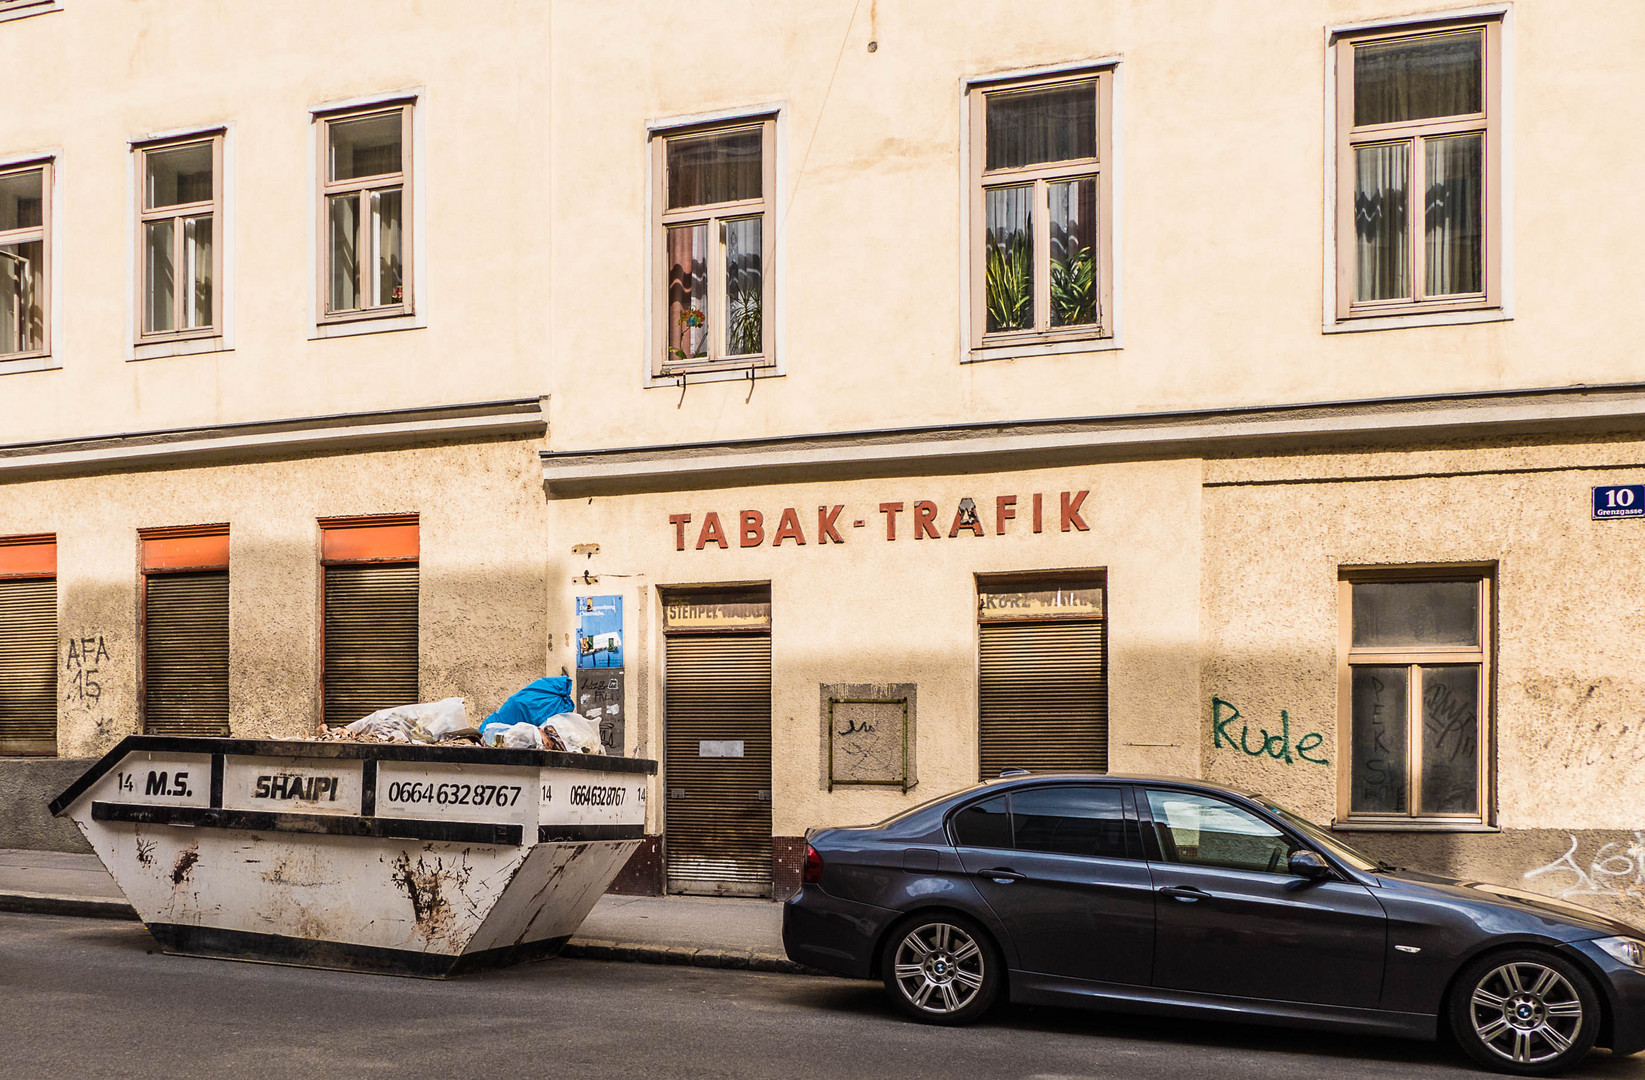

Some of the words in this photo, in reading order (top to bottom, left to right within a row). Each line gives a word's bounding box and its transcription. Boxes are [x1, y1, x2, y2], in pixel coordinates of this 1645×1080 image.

[1597, 508, 1643, 516] Grenzgasse
[1605, 488, 1634, 507] 10
[669, 490, 1091, 551] TABAK-TRAFIK
[66, 635, 110, 670] AFA
[72, 668, 101, 701] 15
[1212, 695, 1330, 766] Rude
[117, 772, 134, 792] 14
[145, 770, 193, 797] M.S.
[542, 785, 552, 802] 14
